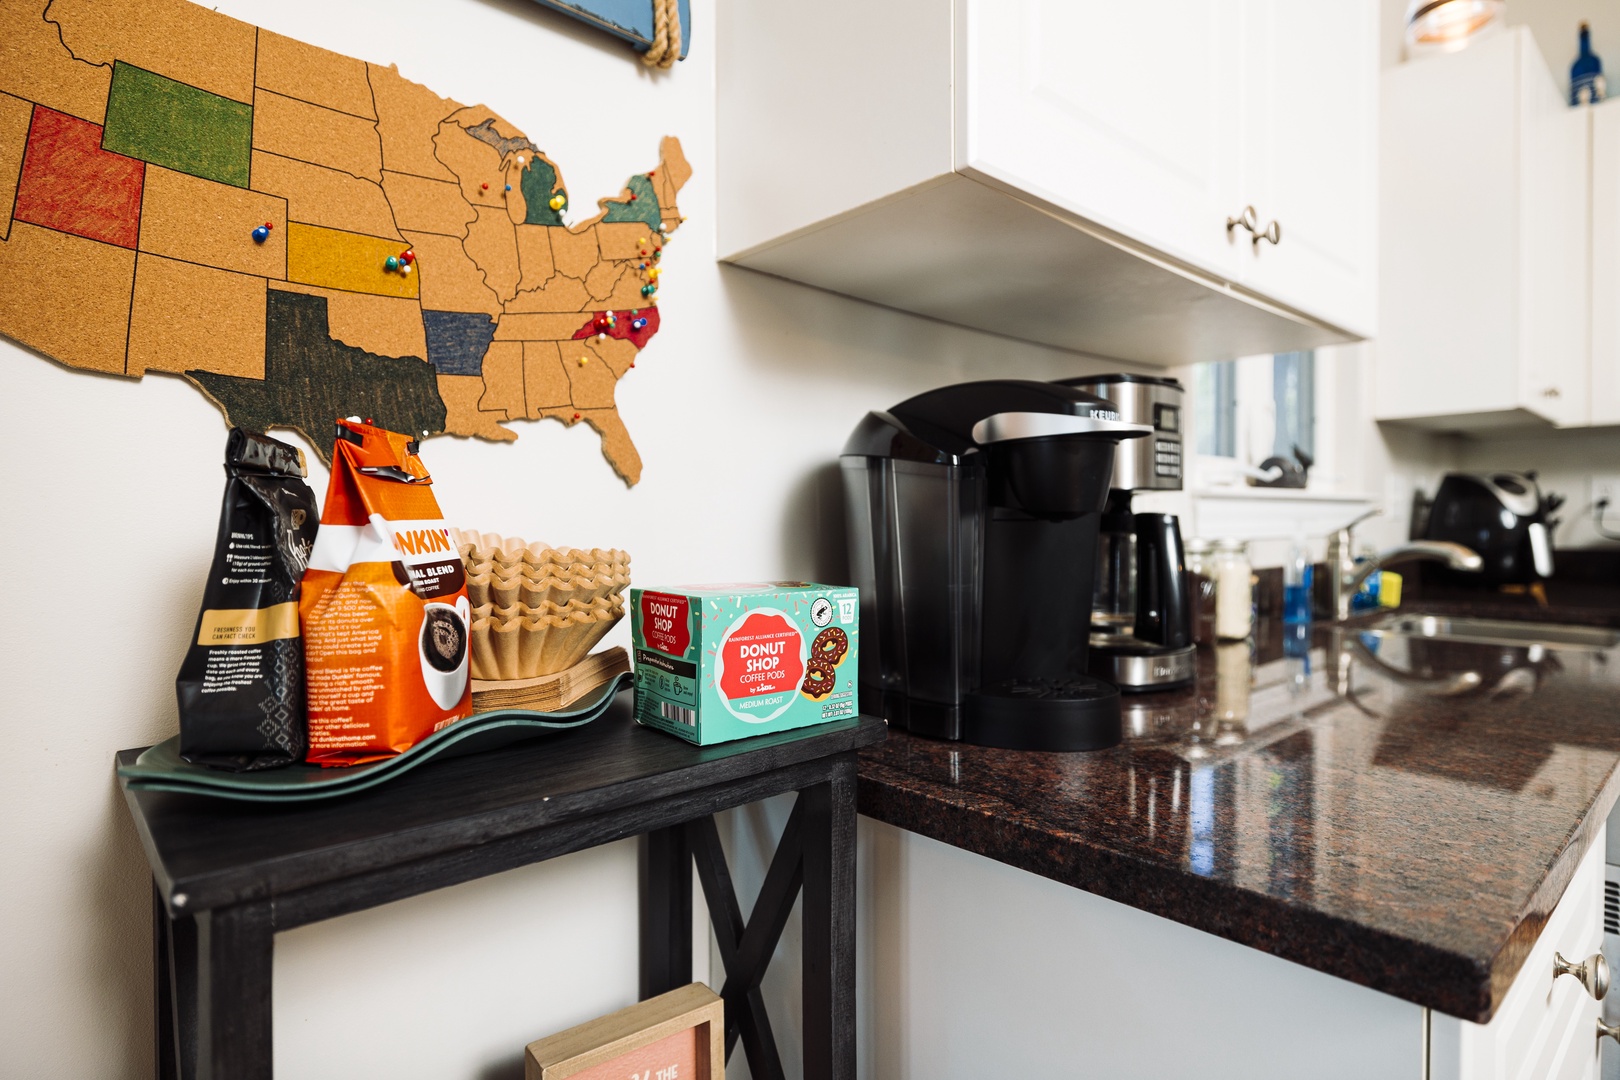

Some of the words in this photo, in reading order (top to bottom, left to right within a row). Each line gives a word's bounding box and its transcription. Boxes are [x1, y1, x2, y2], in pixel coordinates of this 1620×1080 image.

[1089, 409, 1120, 421] KEURI
[395, 529, 450, 556] NKIN'
[426, 565, 455, 577] BLEND
[650, 602, 678, 619] DONUT
[843, 603, 852, 615] 12
[655, 617, 673, 632] SHOP
[652, 630, 664, 641] COFFEE
[664, 634, 677, 645] PODS
[728, 635, 755, 643] RAINFOREST
[740, 641, 786, 658] DONUT
[746, 656, 780, 673] SHOP
[740, 673, 765, 684] COFFEE
[767, 670, 785, 680] PODS
[319, 686, 352, 694] unmatched
[330, 699, 347, 707] great
[739, 700, 764, 710] MEDIUM
[765, 696, 783, 706] ROAST
[330, 716, 353, 724] coffee?
[342, 722, 370, 730] delicious
[319, 734, 376, 743] dunkinathome.com
[655, 1064, 678, 1080] THE
